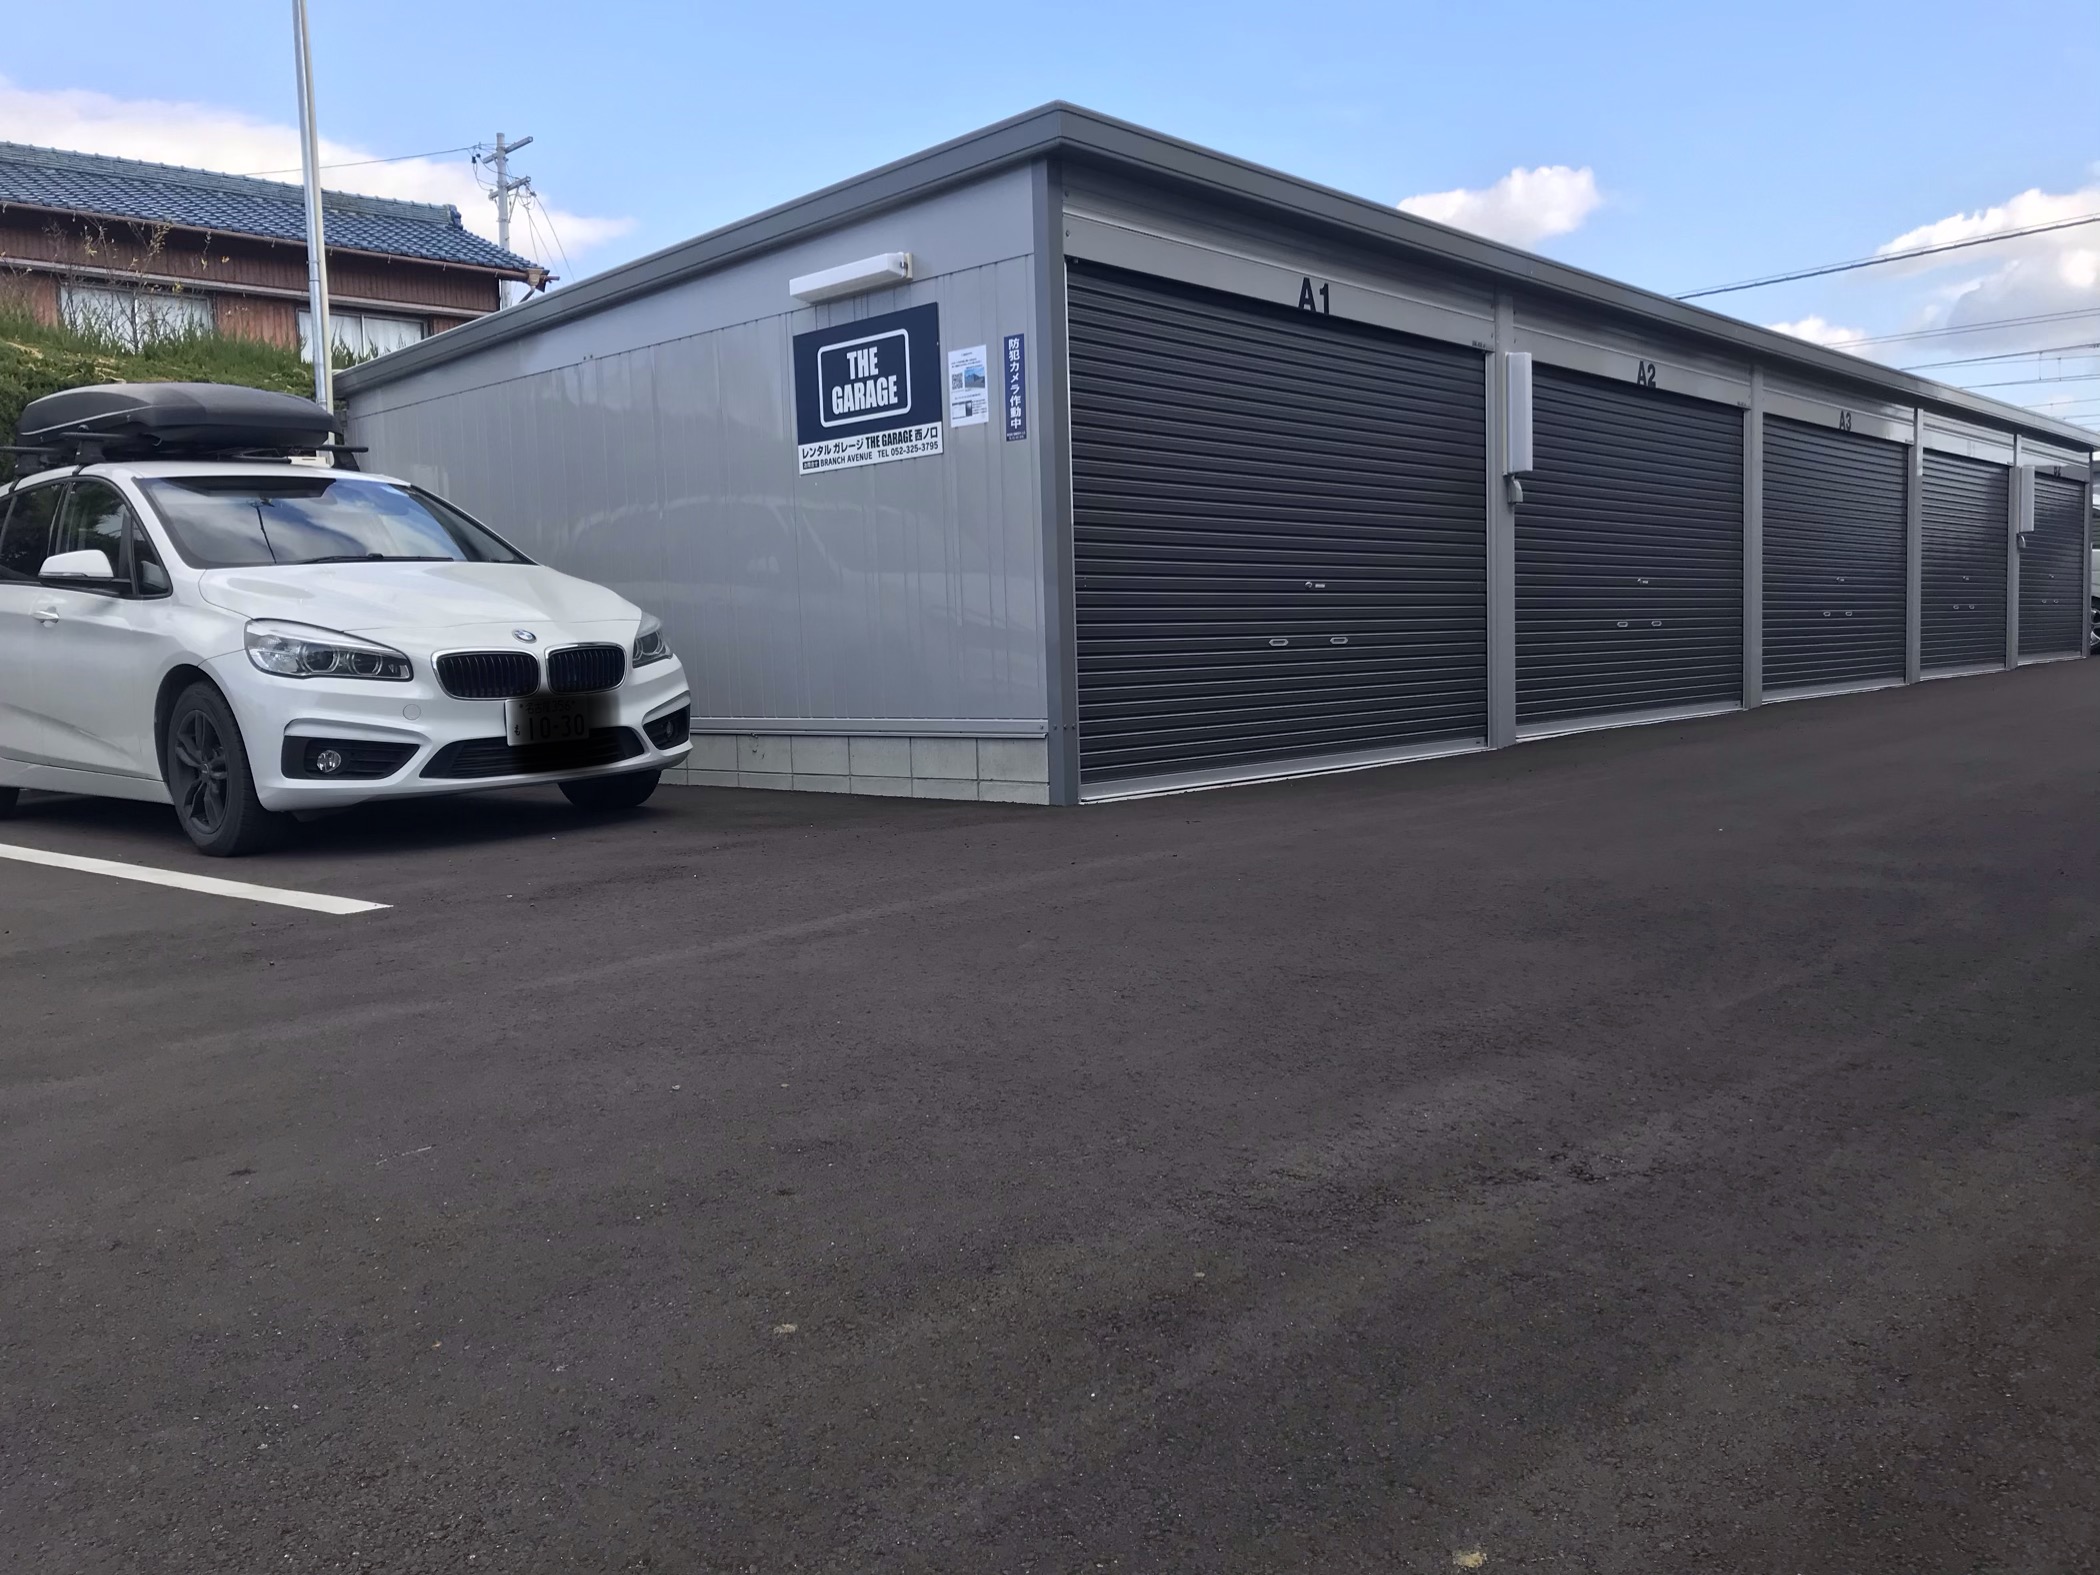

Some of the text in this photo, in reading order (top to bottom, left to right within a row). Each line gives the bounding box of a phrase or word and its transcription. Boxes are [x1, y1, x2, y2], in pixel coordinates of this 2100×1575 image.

[1298, 276, 1330, 316] A1
[846, 346, 879, 380] THE
[1636, 360, 1657, 389] A2
[831, 374, 898, 415] GARAGE
[1008, 338, 1022, 430] 防犯カメラ作動中
[1839, 409, 1852, 432] A3
[820, 455, 846, 467] BRANCH
[847, 451, 873, 463] AVENUE
[877, 449, 890, 459] TEL
[890, 441, 939, 456] 052-325-3795
[865, 434, 881, 450] THE
[881, 429, 913, 447] GARAGE
